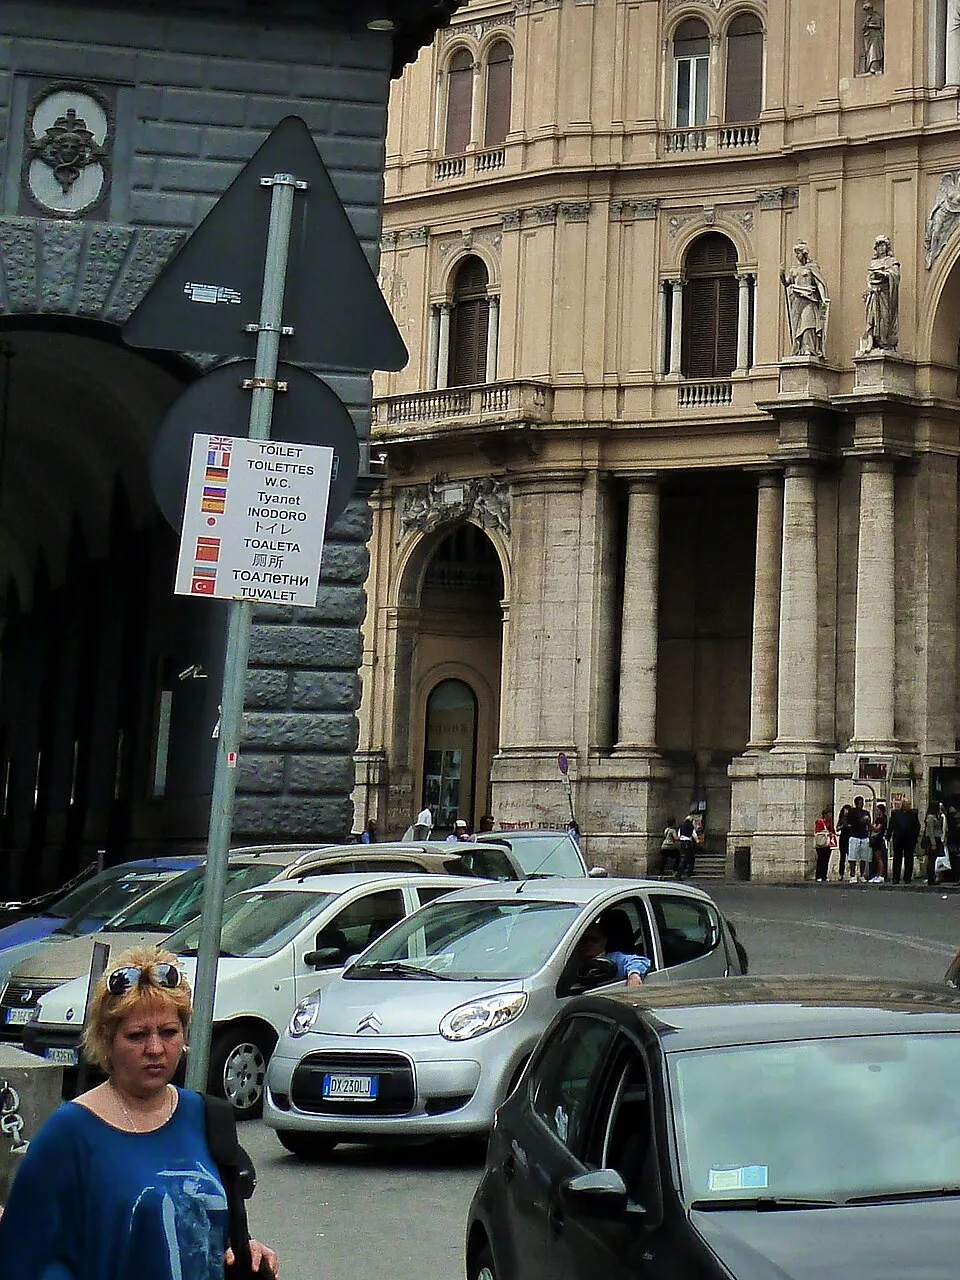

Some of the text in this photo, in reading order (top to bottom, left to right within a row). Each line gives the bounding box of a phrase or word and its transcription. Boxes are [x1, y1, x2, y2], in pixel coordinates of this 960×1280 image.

[258, 444, 303, 458] TOILET
[247, 459, 314, 476] TOILETTES
[265, 477, 291, 488] W.C.
[248, 507, 307, 521] INODORO
[255, 521, 292, 535] トイレ
[243, 538, 300, 553] TOALETA
[240, 587, 296, 601] TUVALET
